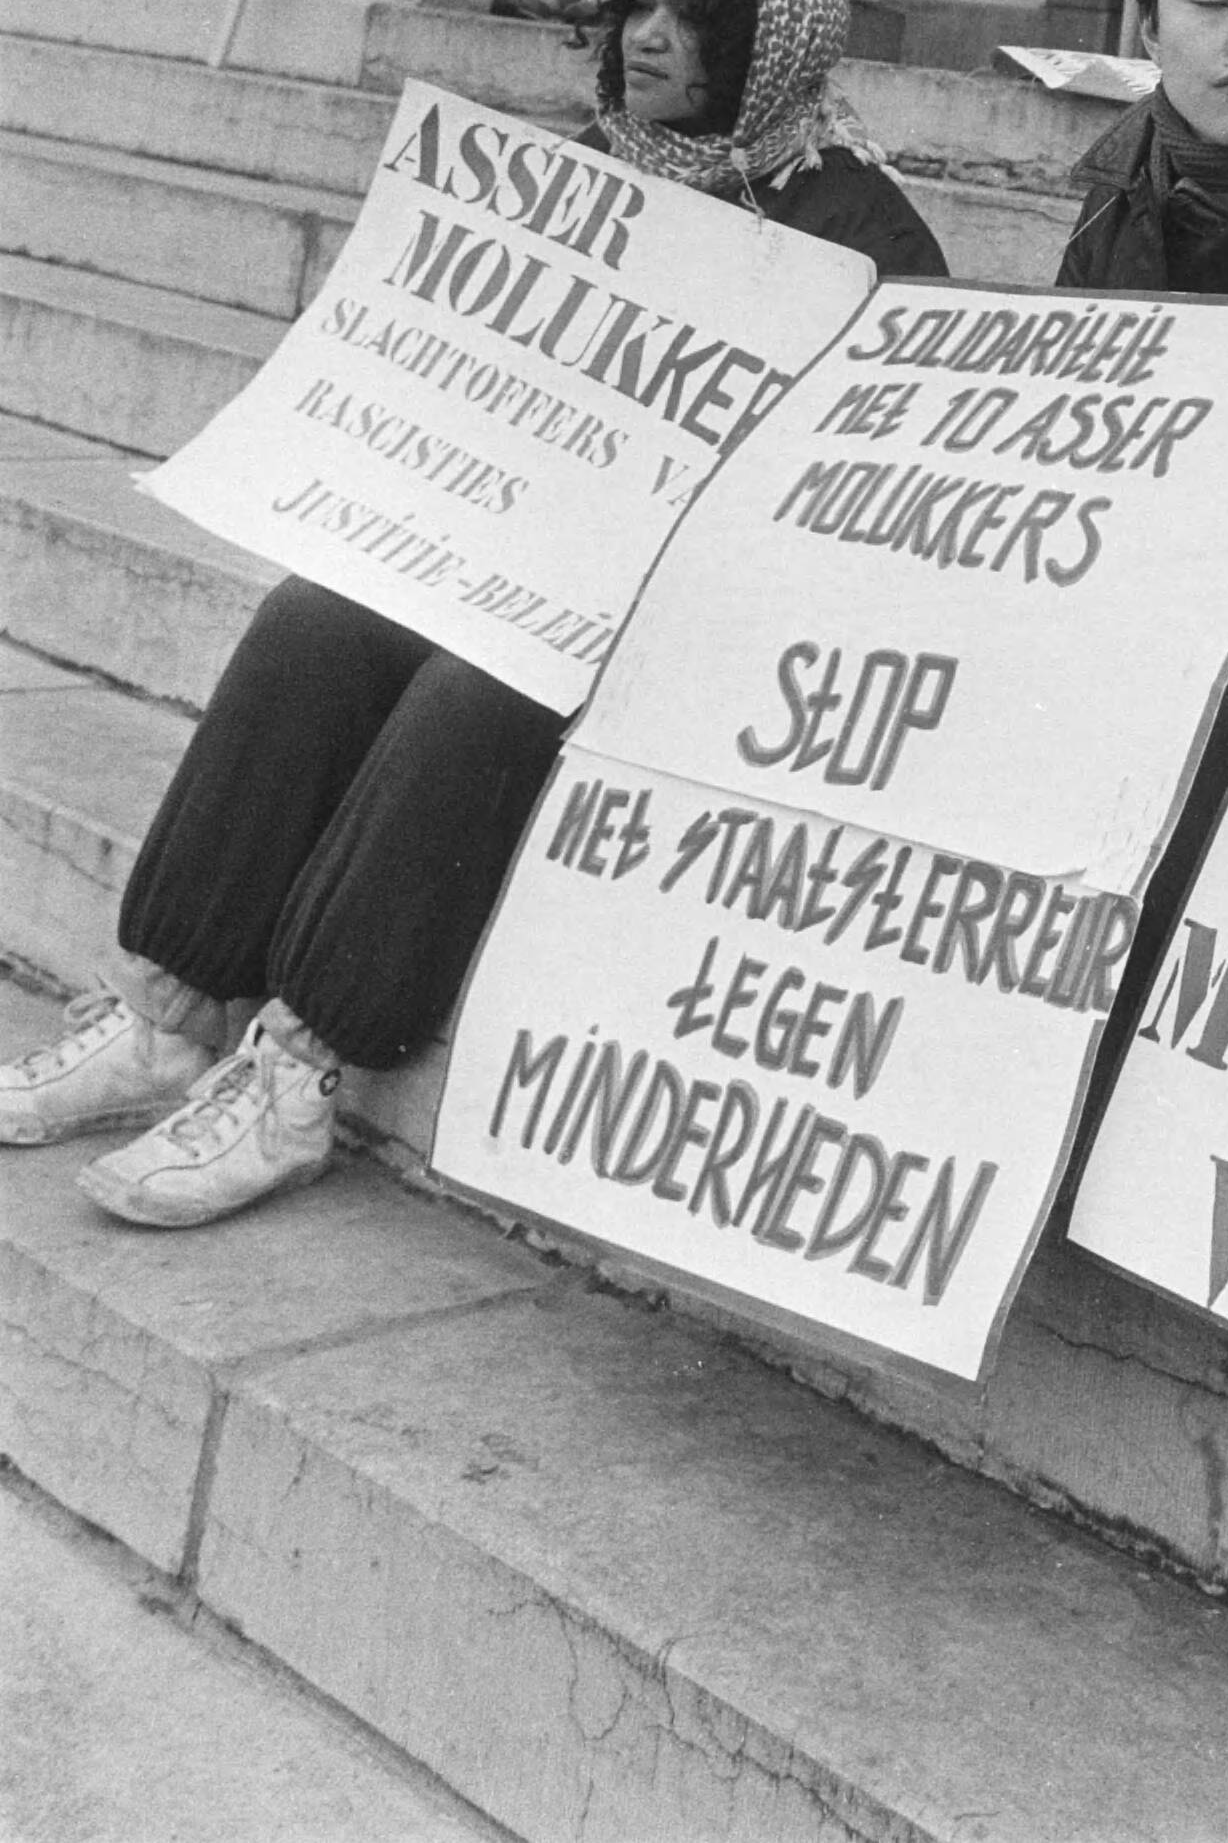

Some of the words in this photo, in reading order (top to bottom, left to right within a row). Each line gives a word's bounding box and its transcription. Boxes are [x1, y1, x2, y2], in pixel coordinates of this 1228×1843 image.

[385, 102, 647, 270] ASSER
[295, 378, 530, 514] RASCISTIES
[320, 296, 630, 469] SLACHTOFFERS
[919, 387, 1020, 453] 10
[992, 393, 1215, 479] ASSER
[773, 459, 1113, 588] MOLUKKERS
